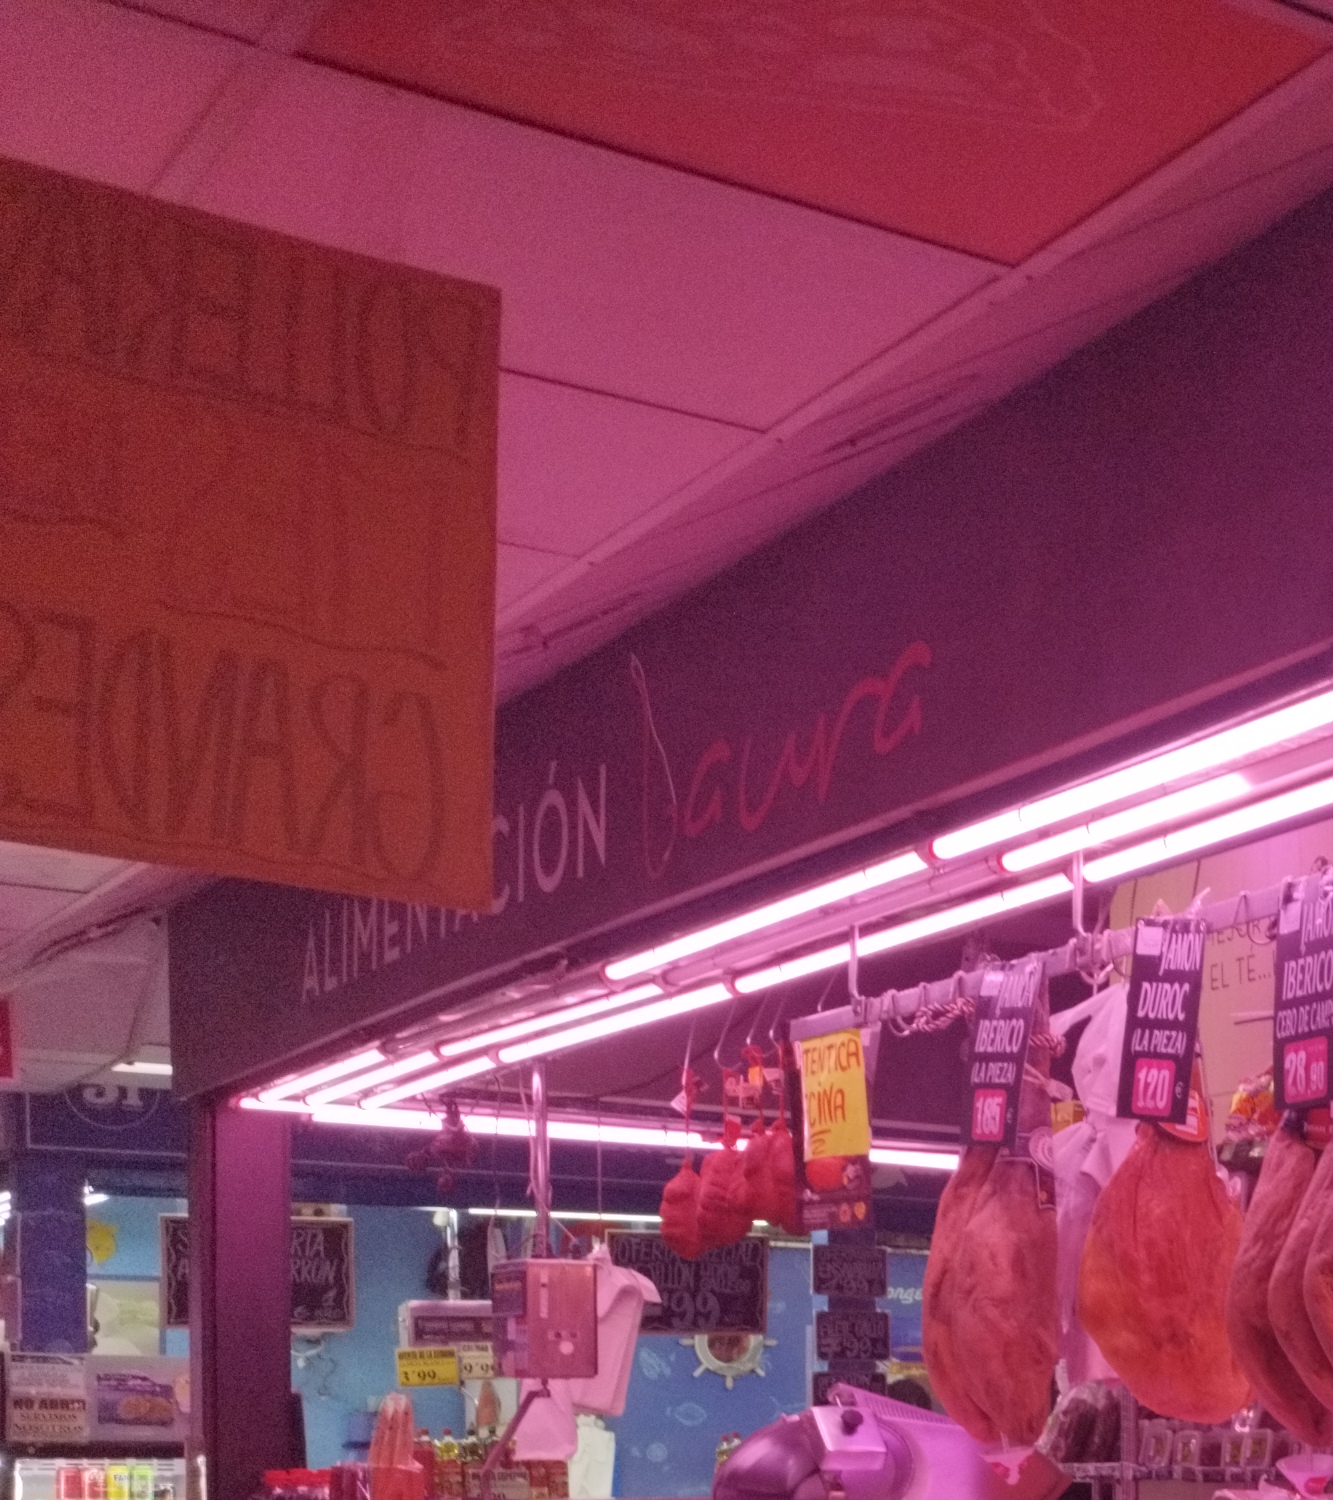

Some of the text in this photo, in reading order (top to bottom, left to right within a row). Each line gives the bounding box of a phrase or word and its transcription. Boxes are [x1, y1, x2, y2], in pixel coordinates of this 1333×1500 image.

[1136, 982, 1190, 1021] DUROC
[1151, 1030, 1188, 1056] PIEZA)
[1136, 1064, 1170, 1111] 120
